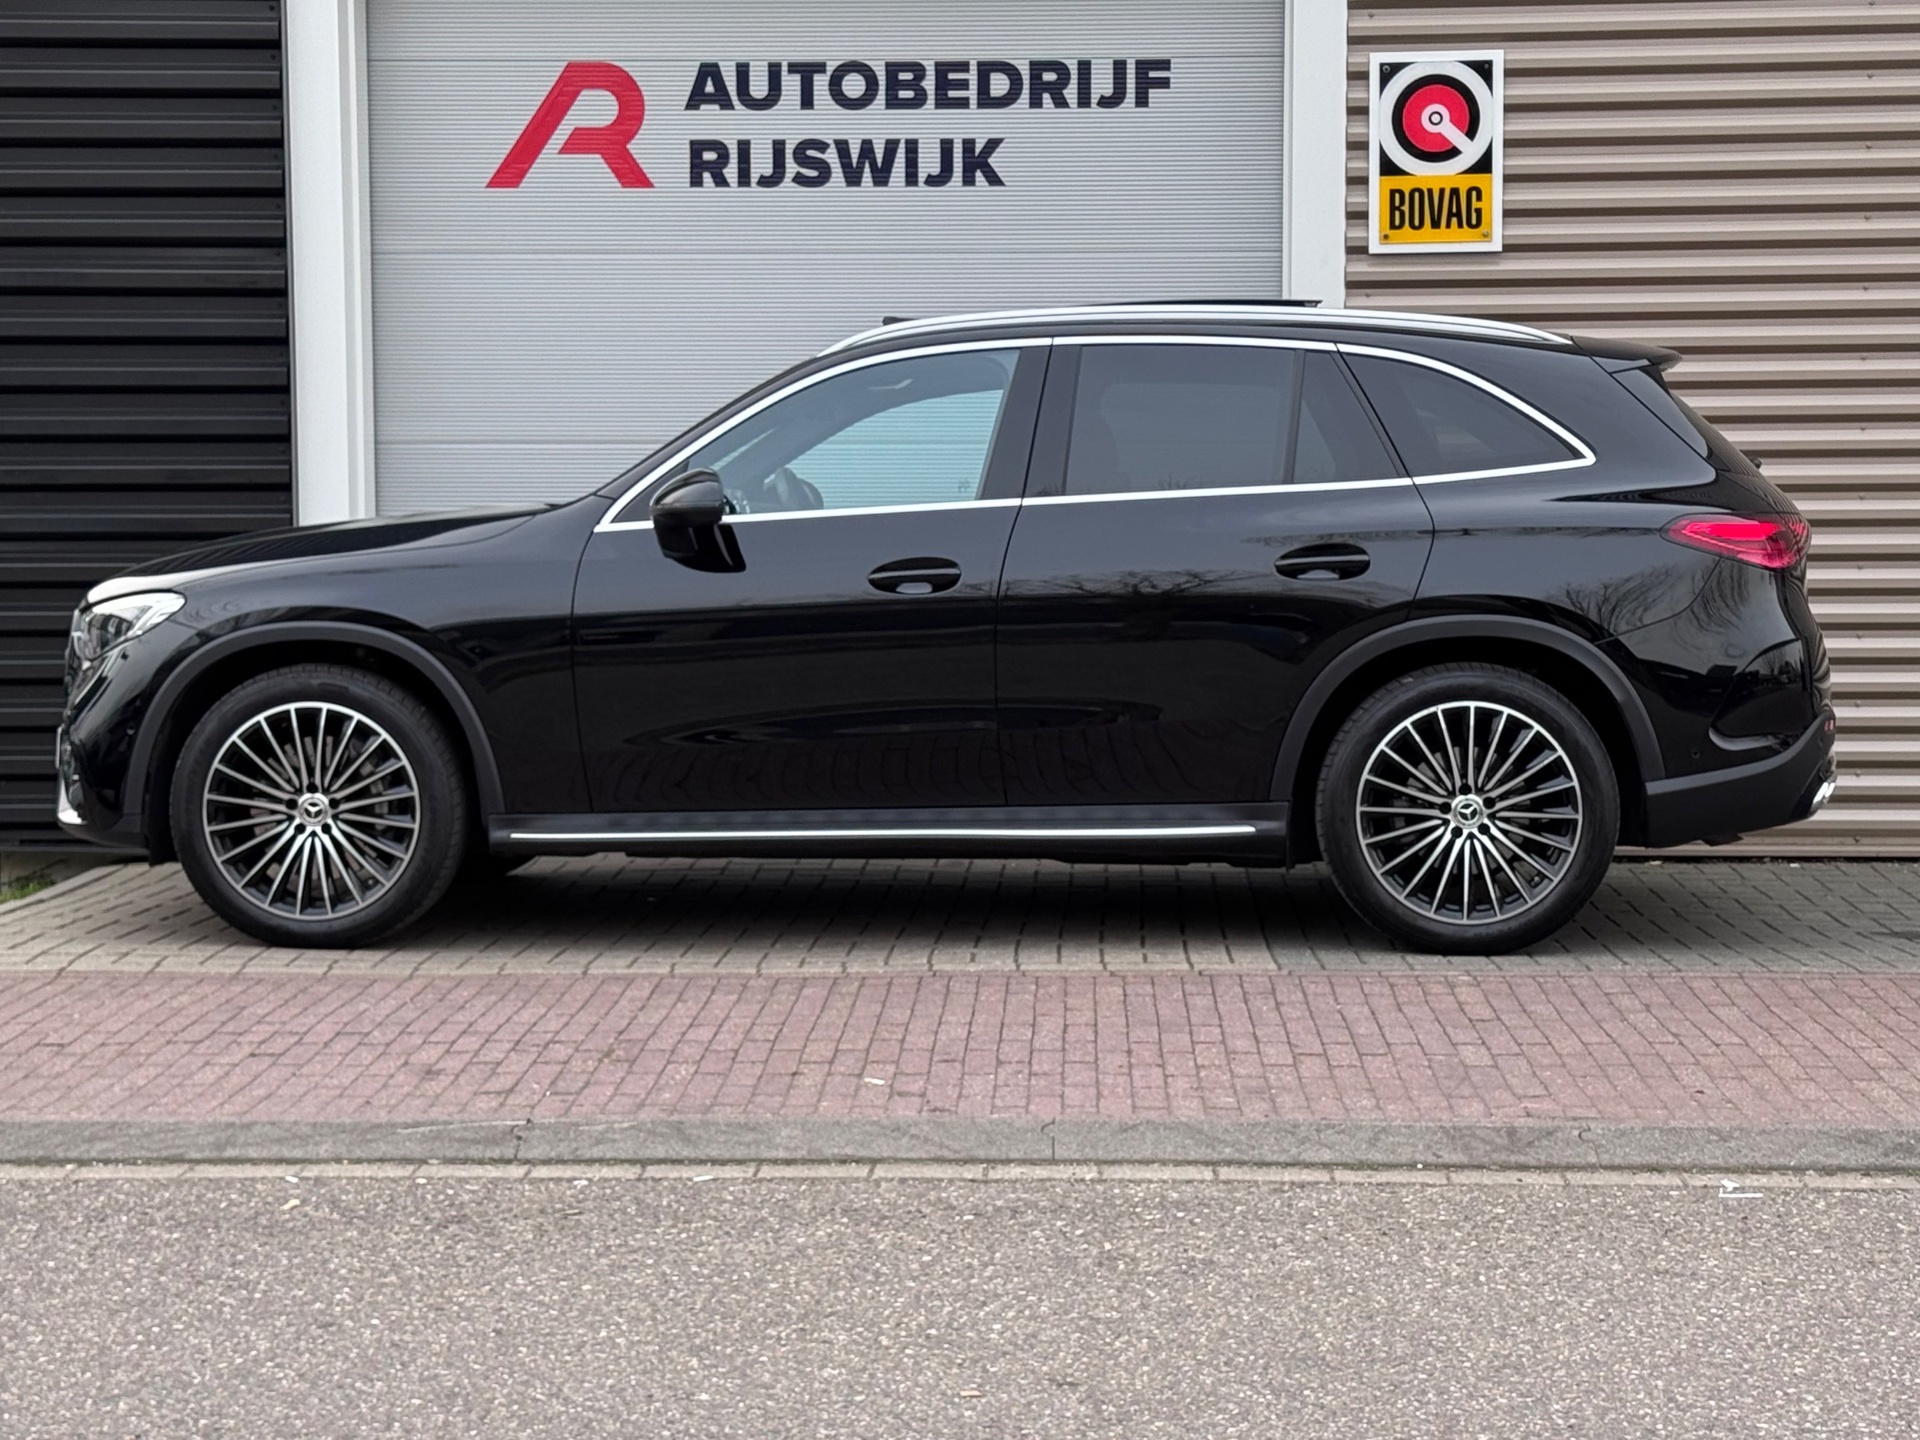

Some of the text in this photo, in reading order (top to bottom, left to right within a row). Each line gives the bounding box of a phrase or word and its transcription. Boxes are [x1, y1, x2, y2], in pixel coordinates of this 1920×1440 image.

[685, 59, 1171, 111] AUTOBEDRIJF
[690, 138, 1005, 188] RIJSWIJK
[1388, 186, 1483, 230] BOVAG
